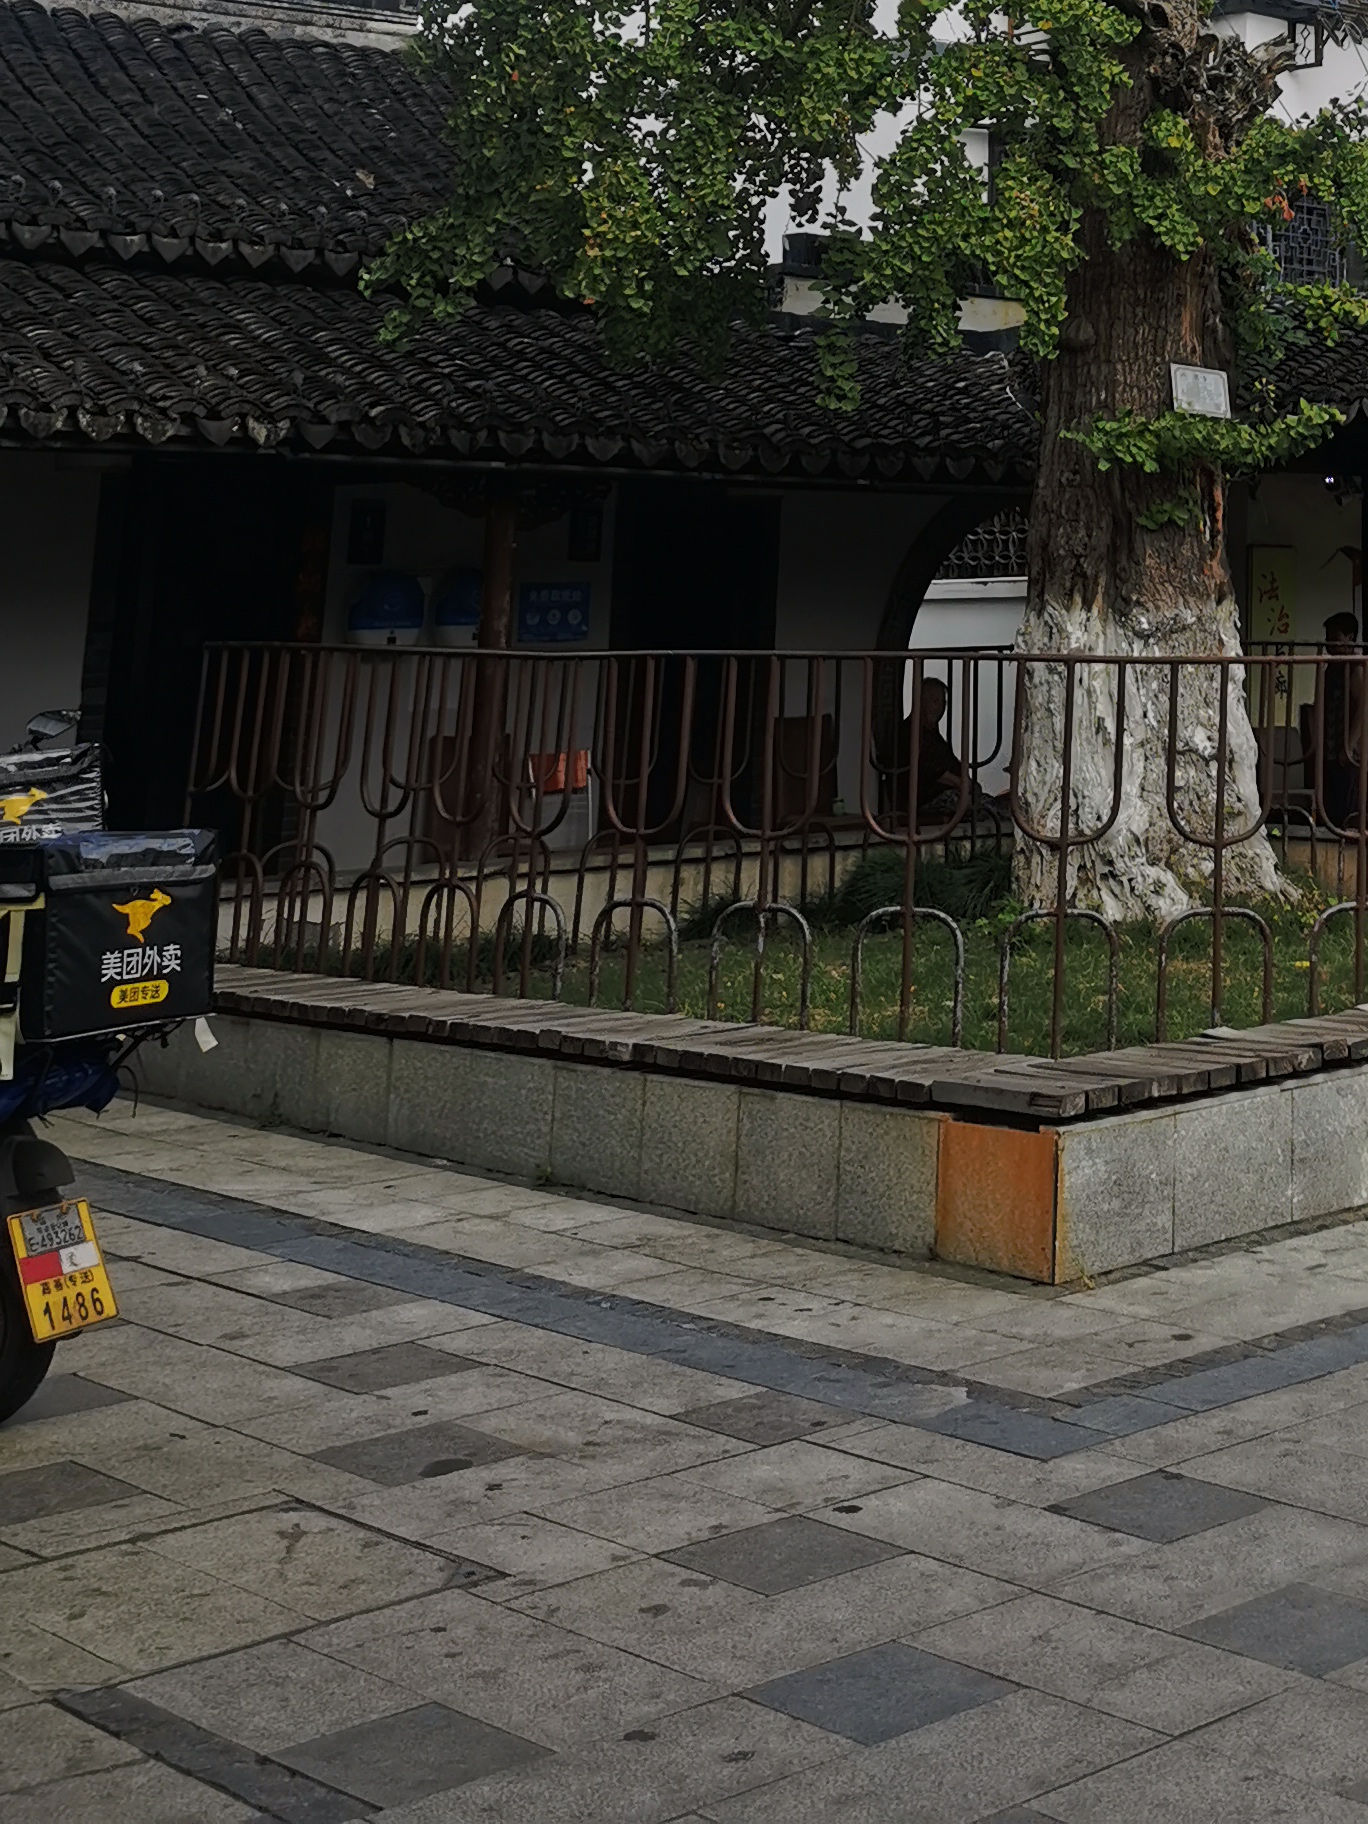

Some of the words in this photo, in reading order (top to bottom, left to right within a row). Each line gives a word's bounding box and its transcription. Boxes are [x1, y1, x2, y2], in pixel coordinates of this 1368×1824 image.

[101, 943, 182, 983] 美团外卖
[118, 983, 161, 1004] 美团专送
[43, 1287, 105, 1331] 1486
